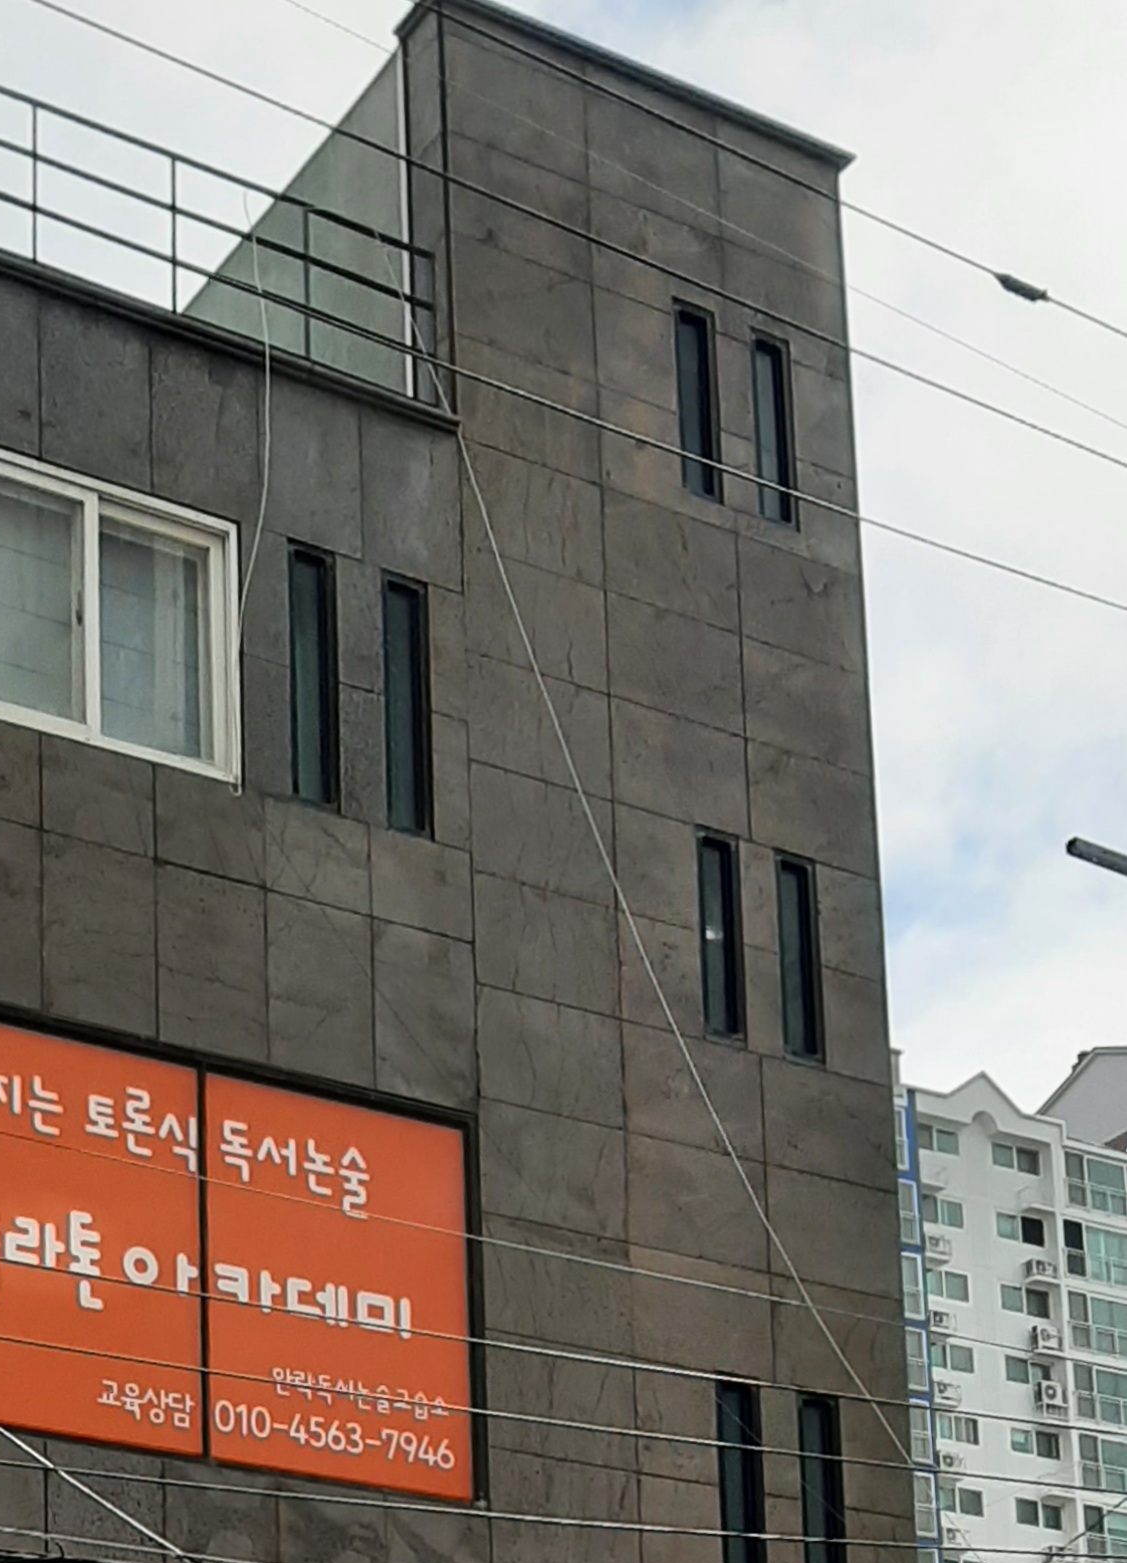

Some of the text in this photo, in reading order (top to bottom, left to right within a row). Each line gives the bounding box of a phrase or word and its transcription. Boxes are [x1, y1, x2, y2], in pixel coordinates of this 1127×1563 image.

[85, 1086, 199, 1172] 토론식
[219, 1121, 370, 1220] 독서논술
[123, 1247, 412, 1339] 아카데미
[96, 1379, 196, 1428] 교육상담
[214, 1400, 455, 1470] 010-4563-7946
